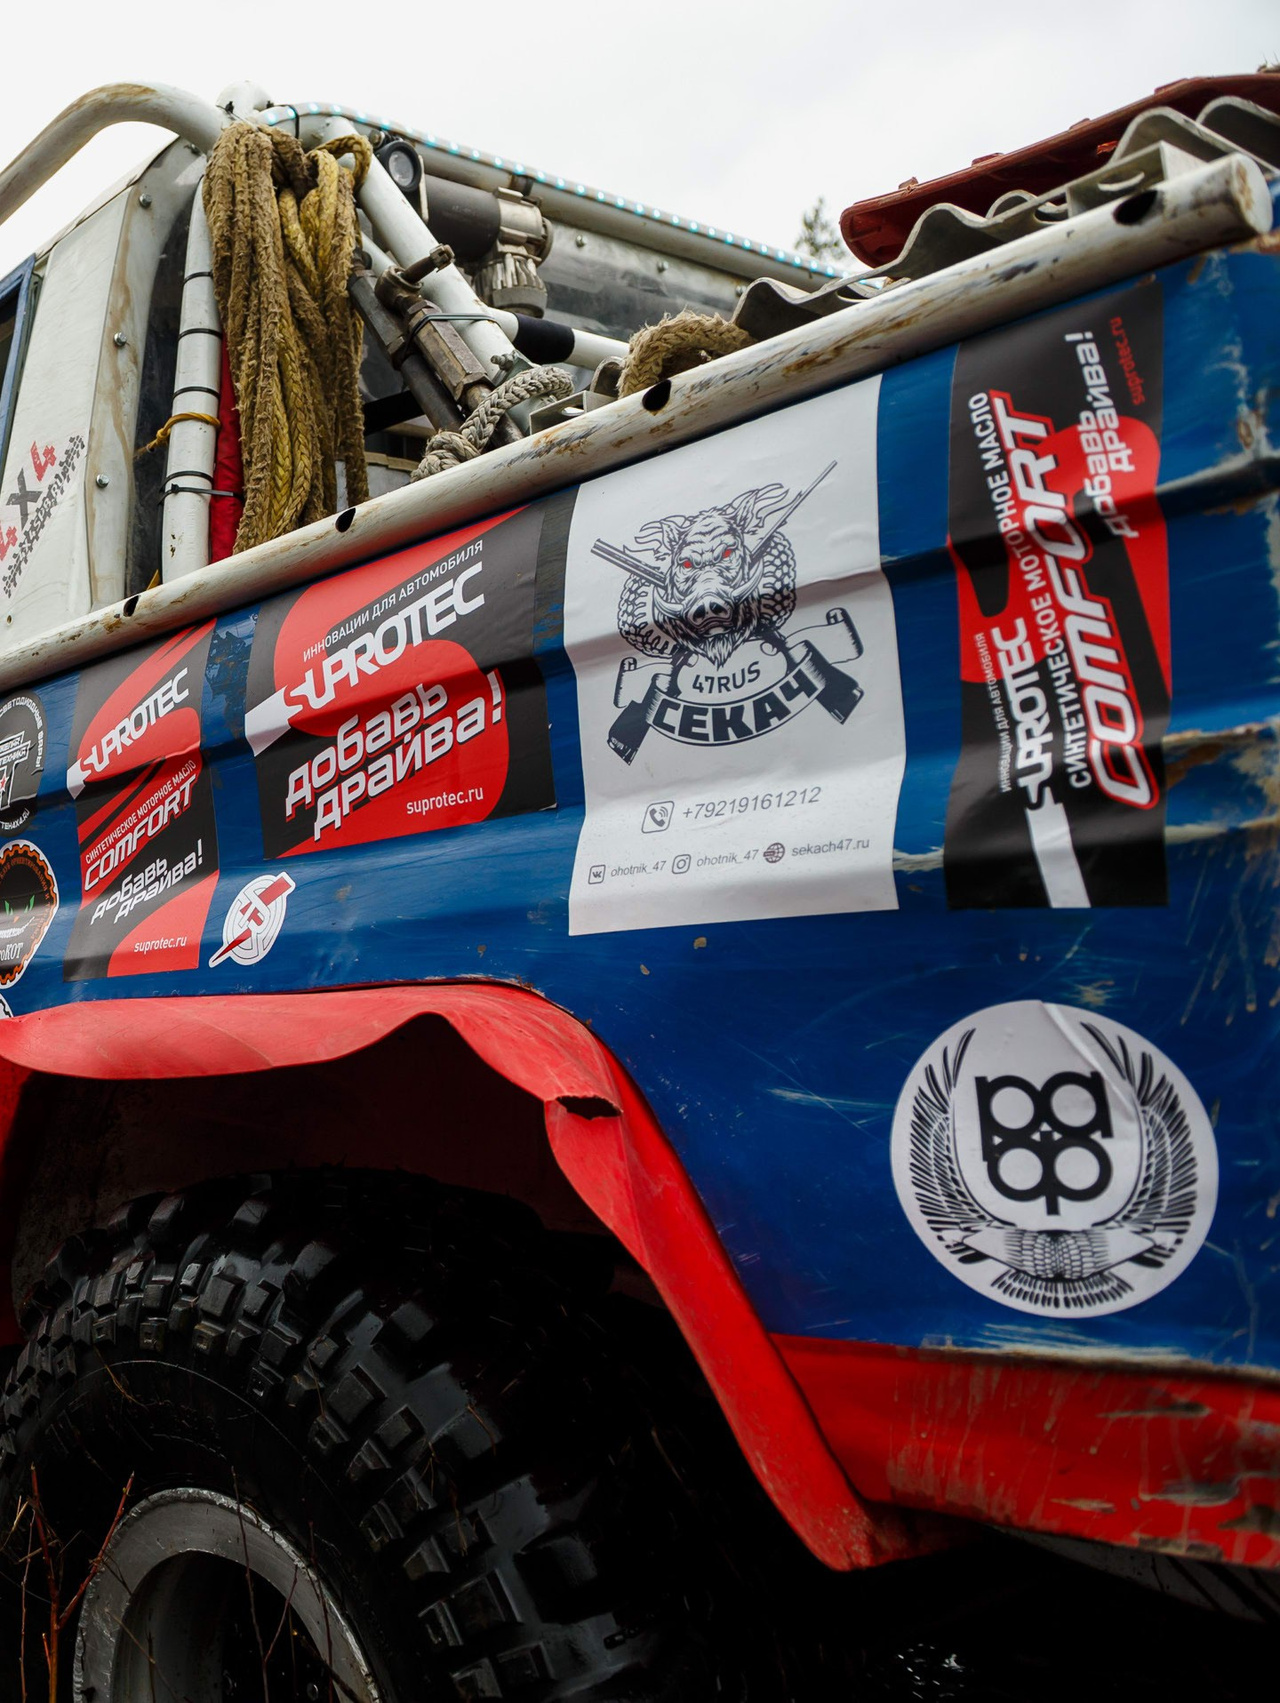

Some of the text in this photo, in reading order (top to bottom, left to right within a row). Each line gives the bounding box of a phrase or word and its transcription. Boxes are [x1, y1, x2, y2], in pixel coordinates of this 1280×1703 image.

[303, 540, 483, 662] ИННОВАЦИИ ДЛЯ АВТОМОБИЛЯ
[968, 391, 1093, 788] СИНТЕТИЧЕСКОЕ МОТОРНОЕ МАСЛО
[992, 395, 1152, 806] COMFORT
[692, 661, 761, 694] 47RUS
[974, 632, 1002, 704] АВТОМОБИЛЯ
[652, 668, 818, 742] СЕКАЧ
[993, 706, 1010, 729] ДЛЯ
[84, 773, 197, 891] COMFORT
[85, 760, 197, 864] СИНТЕТИЧЕСКОЕ МОТОРНОЕ МАСЛО
[406, 785, 484, 815] suprotec.ru
[682, 786, 822, 820] +79219161212
[610, 861, 666, 878] ohotnik_47
[696, 850, 759, 868] ohotnik_47
[791, 838, 870, 857] sekach47.ru
[134, 936, 187, 955] suprotec.ru
